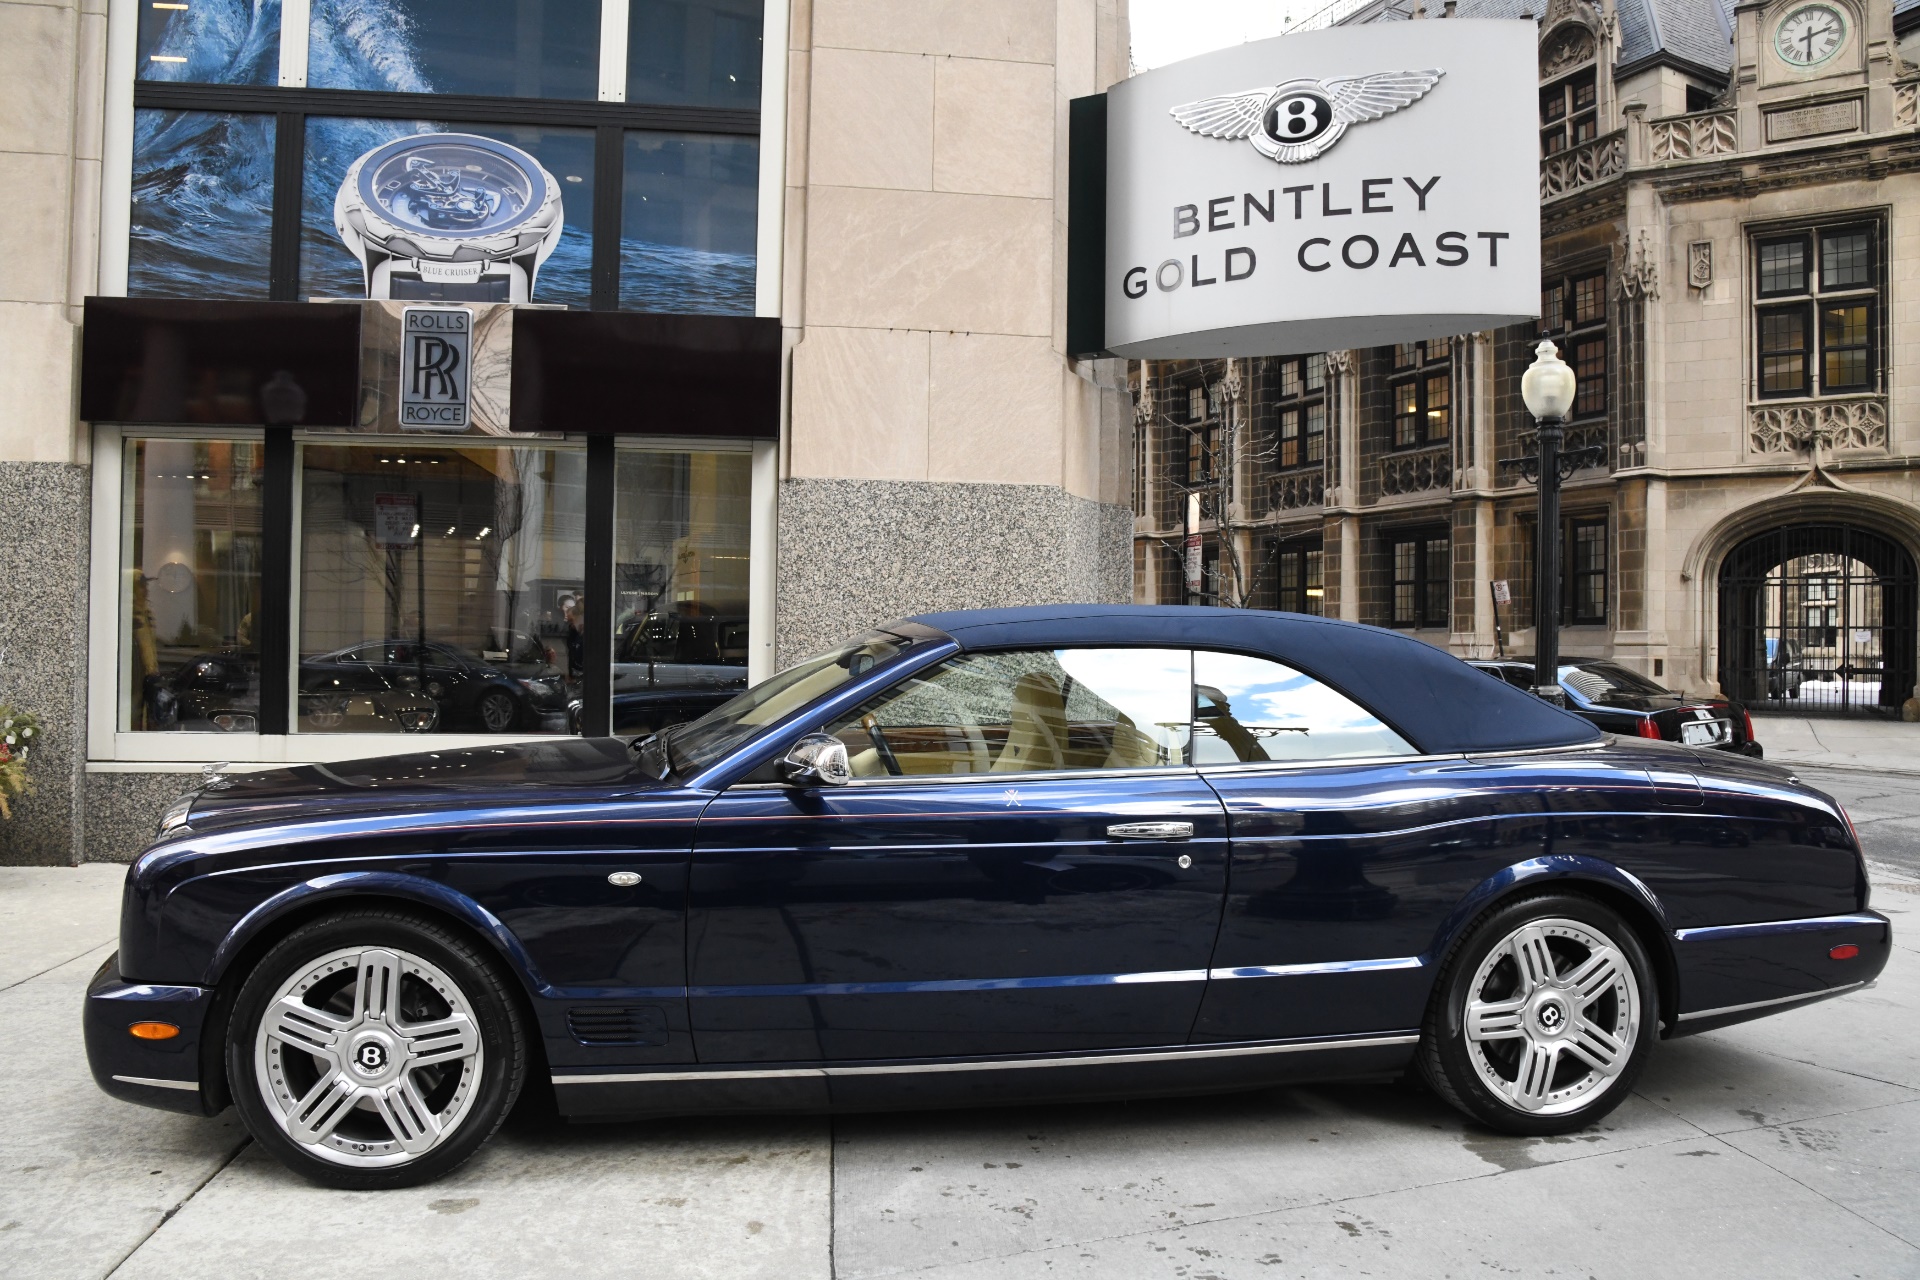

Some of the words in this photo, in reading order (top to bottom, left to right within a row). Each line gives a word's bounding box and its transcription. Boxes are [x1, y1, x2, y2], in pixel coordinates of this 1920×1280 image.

[1275, 96, 1318, 138] B
[1173, 175, 1442, 240] BENTLEY
[423, 265, 443, 276] BLUE
[444, 267, 478, 277] CRUISER
[1123, 246, 1258, 300] GOLD
[1298, 231, 1511, 273] COAST
[409, 314, 464, 330] ROLLS
[411, 335, 460, 400] RR
[406, 406, 461, 421] ROYCE
[1542, 1006, 1559, 1026] B
[362, 1046, 381, 1066] B
